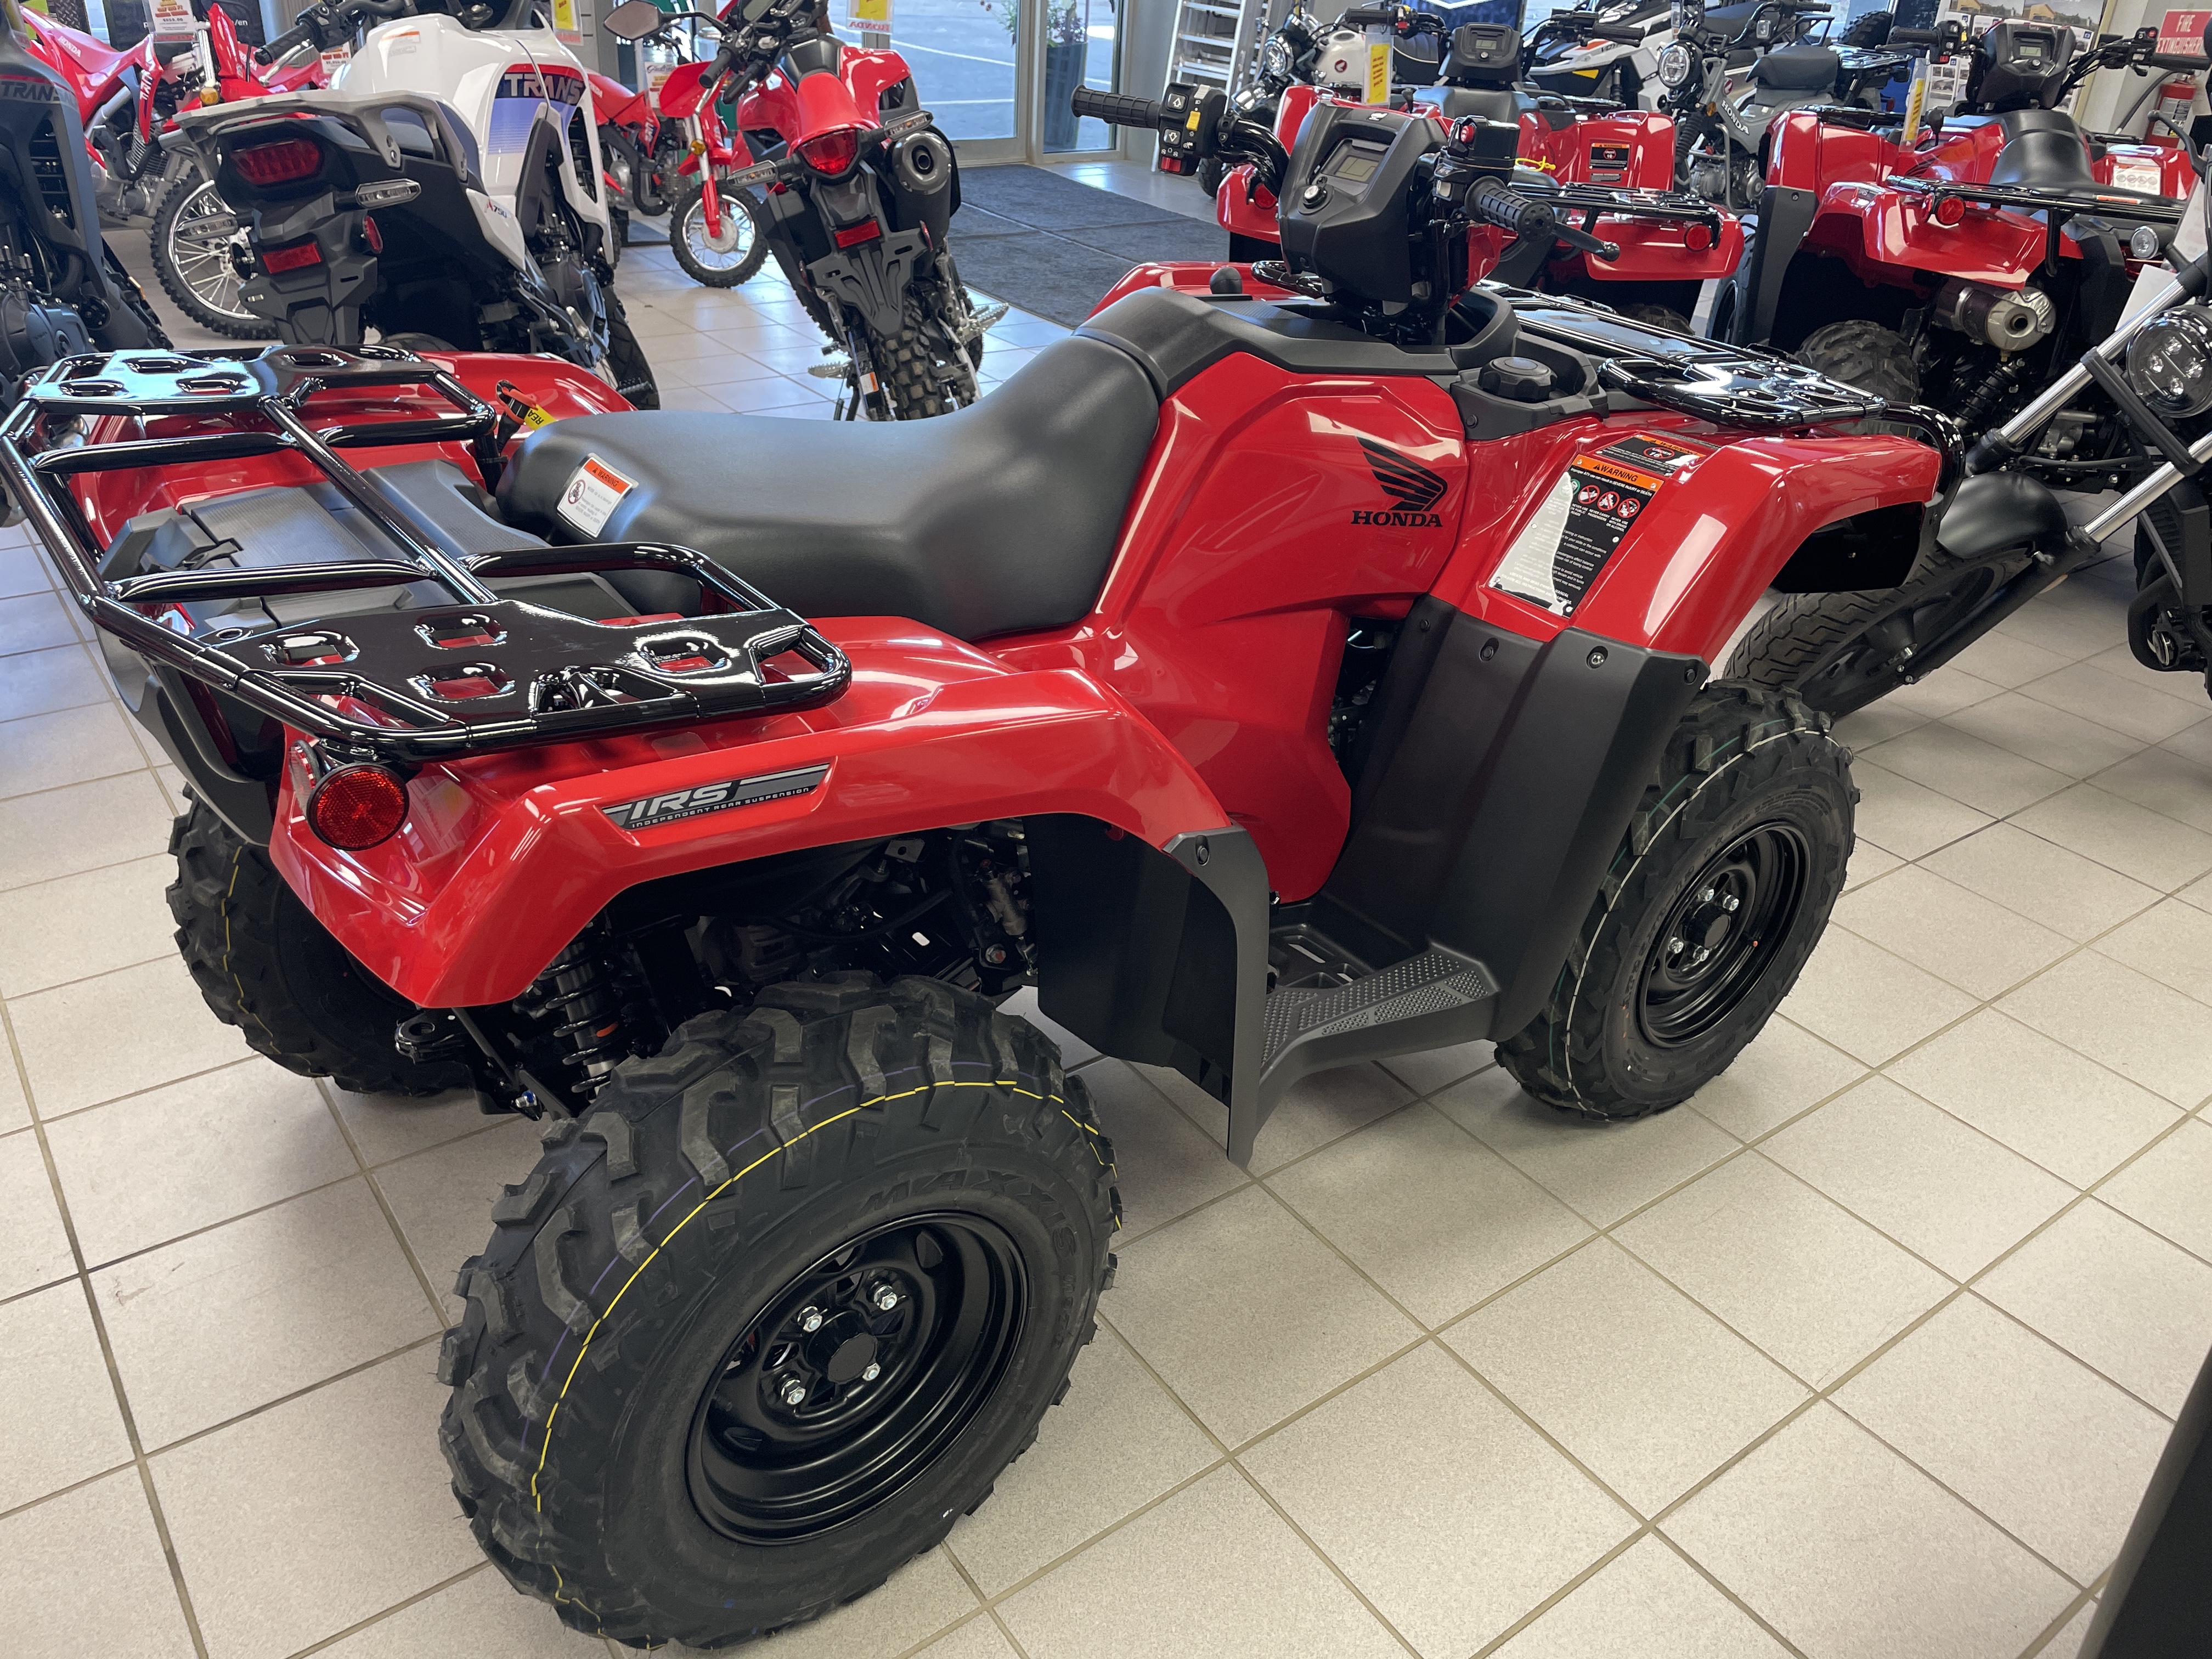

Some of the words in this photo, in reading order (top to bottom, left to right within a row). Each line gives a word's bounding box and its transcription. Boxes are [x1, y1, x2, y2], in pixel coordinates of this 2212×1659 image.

[2176, 14, 2196, 32] FIRE
[58, 36, 81, 57] HONDA
[1722, 100, 1750, 136] HONDA
[597, 470, 619, 487] WARNING
[1600, 464, 1638, 482] WARNING
[1350, 510, 1443, 528] HONDA
[630, 782, 732, 820] IRS
[632, 807, 710, 828] INDEPENDENT
[714, 800, 741, 810] REAR
[745, 787, 810, 804] SUSPENSION
[857, 1168, 1077, 1257] MAXXIS
